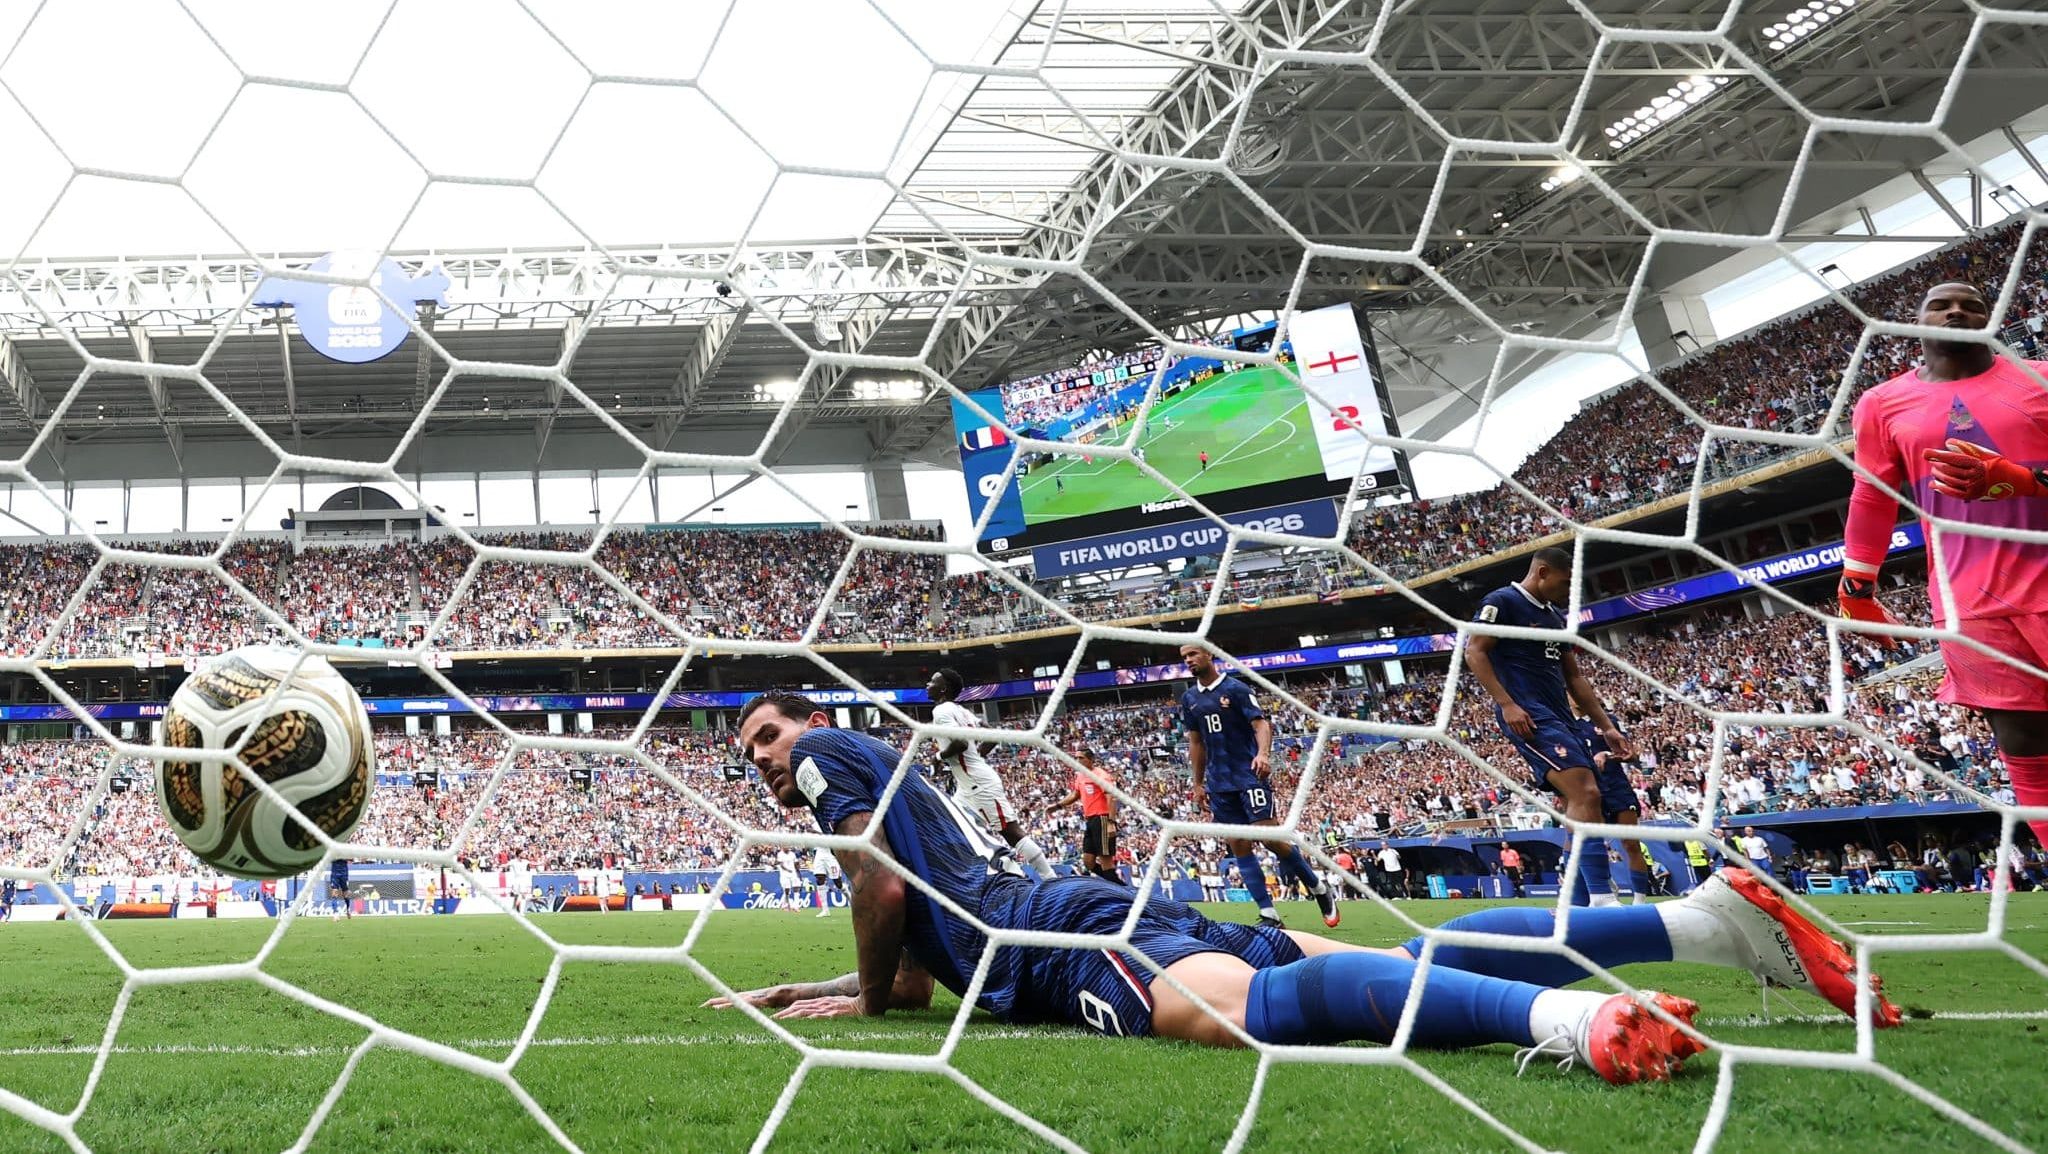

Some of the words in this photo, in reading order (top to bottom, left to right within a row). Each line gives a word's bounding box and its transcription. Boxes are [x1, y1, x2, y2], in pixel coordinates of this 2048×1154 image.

[1331, 406, 1362, 431] 2
[1141, 498, 1192, 514] Hisens
[993, 540, 1006, 550] CC
[1059, 545, 1103, 567] FIFA
[1103, 532, 1176, 560] WORLD
[1180, 527, 1223, 549] CUP
[1766, 553, 1820, 578] WORLD
[1262, 653, 1306, 667] FINAL
[585, 696, 625, 707] MIAMI
[832, 692, 855, 703] CUP
[139, 705, 168, 716] MIA
[1204, 713, 1222, 734] 18
[1247, 788, 1267, 808] 18
[1774, 931, 1808, 983] ULTRA
